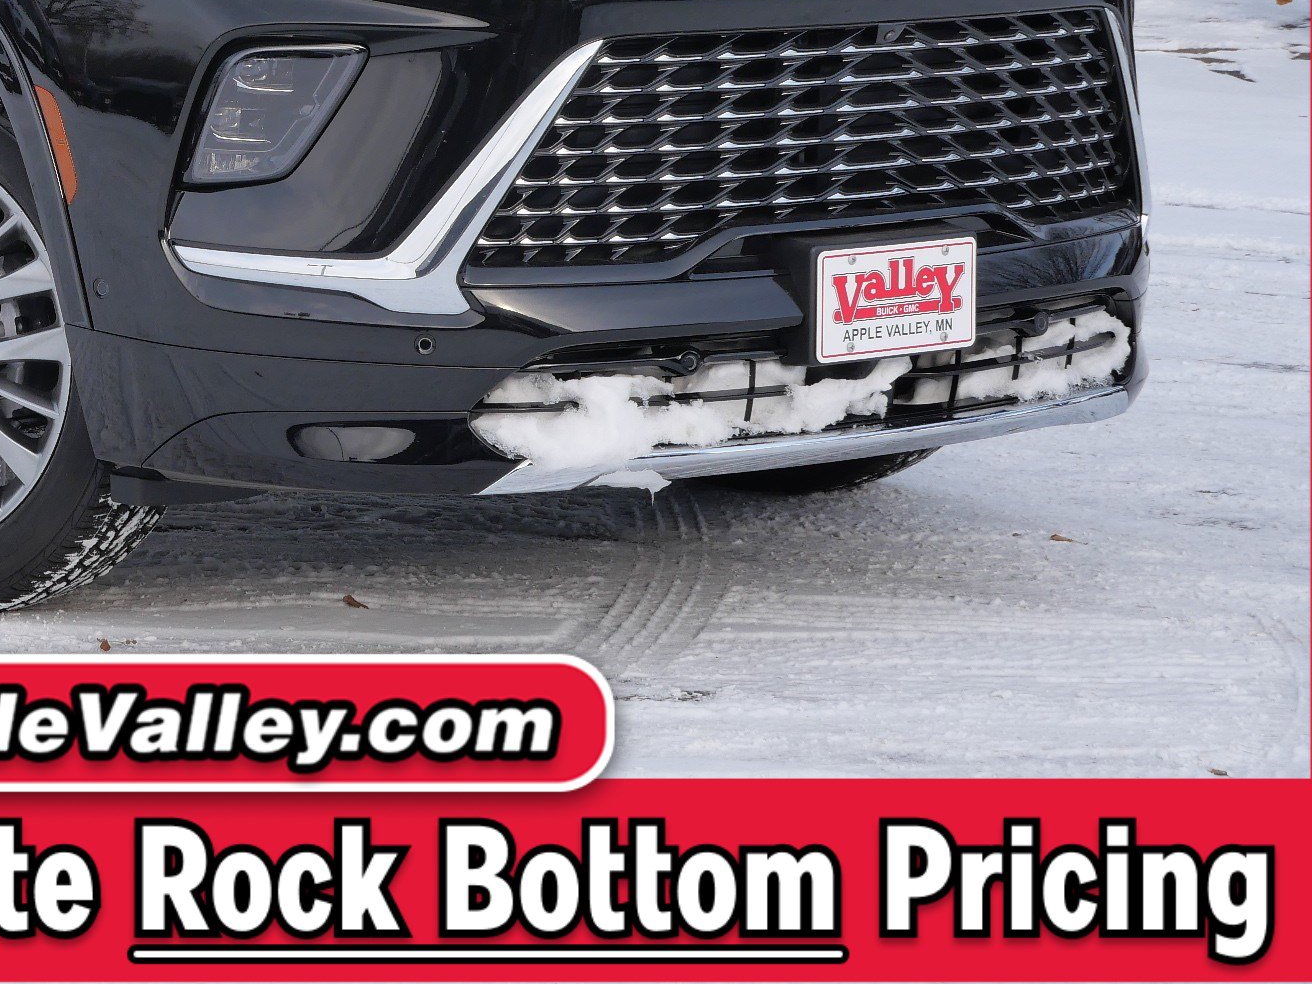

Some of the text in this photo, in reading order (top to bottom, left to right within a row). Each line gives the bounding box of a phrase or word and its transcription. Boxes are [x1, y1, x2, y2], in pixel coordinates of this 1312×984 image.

[875, 303, 920, 317] BUICK GMC
[842, 317, 953, 343] APPLE VALLEY, MN
